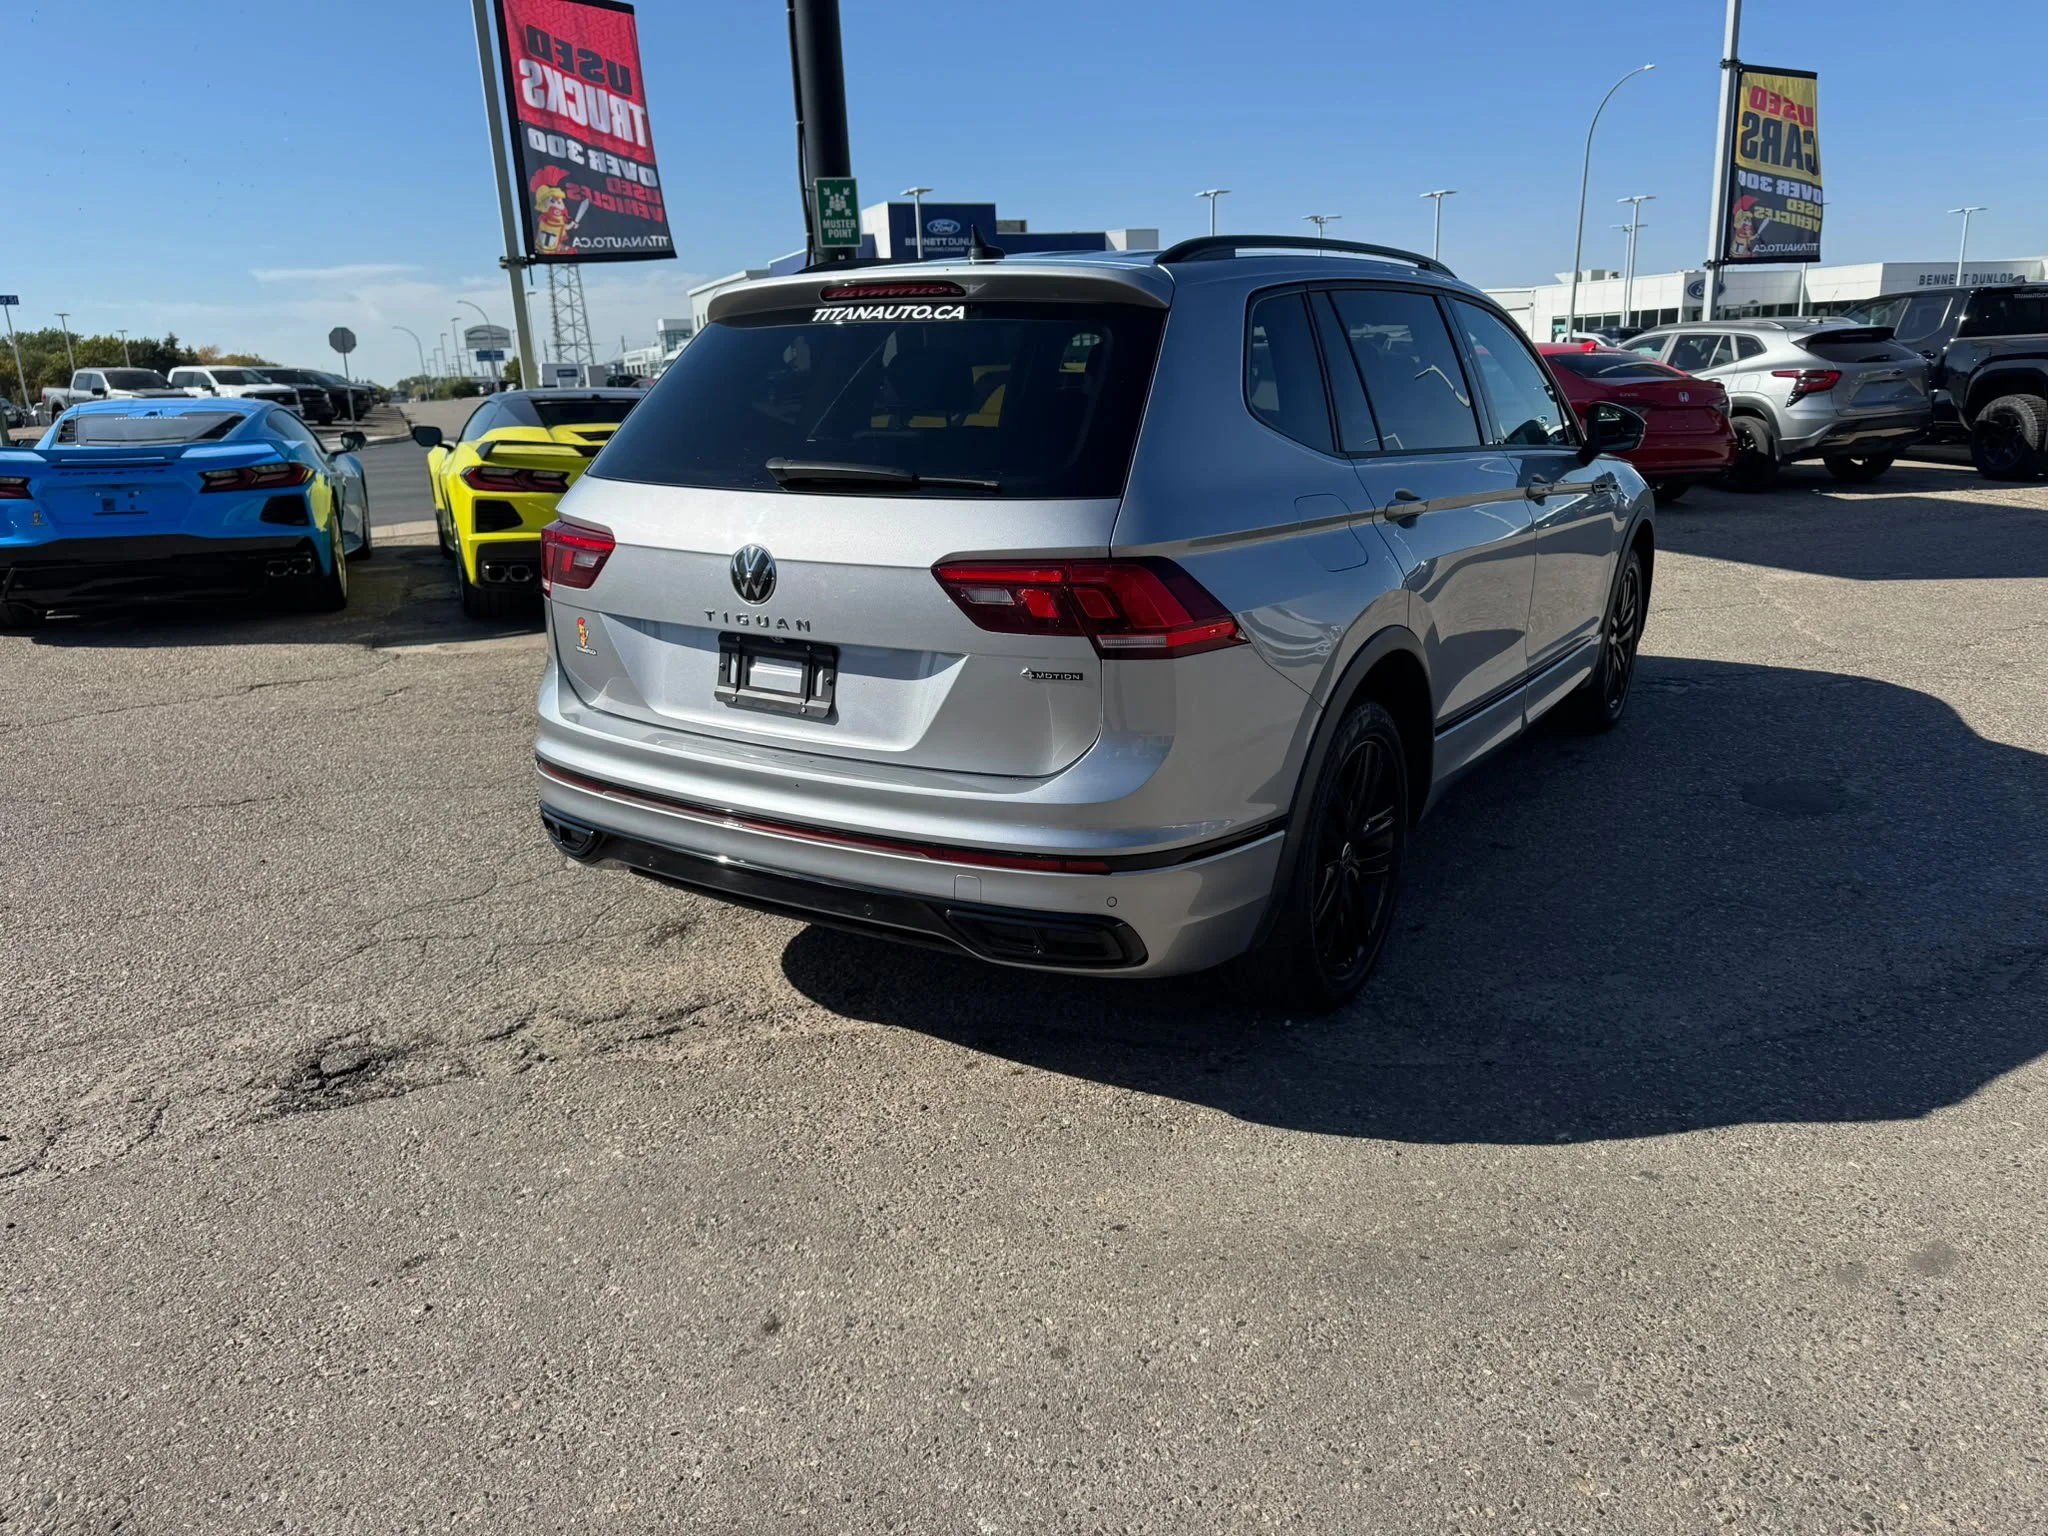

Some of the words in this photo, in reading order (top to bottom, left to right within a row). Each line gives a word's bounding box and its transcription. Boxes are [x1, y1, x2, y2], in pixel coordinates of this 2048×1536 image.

[822, 219, 857, 229] MUSTER
[828, 229, 852, 239] POINT
[1919, 274, 1968, 286] BENNET
[812, 305, 965, 321] TITANAUTO.CA
[703, 608, 811, 632] TIGUAN
